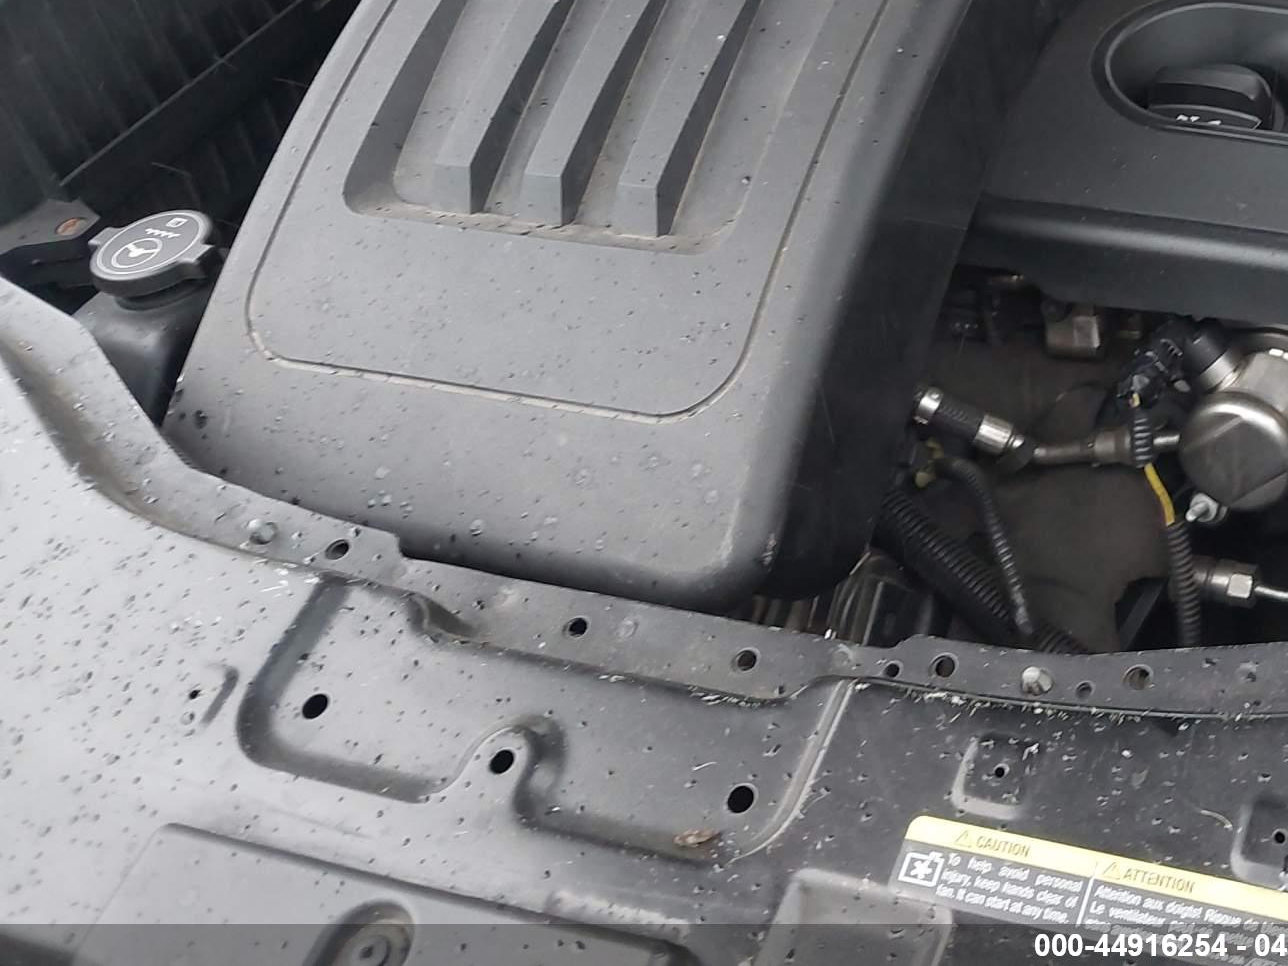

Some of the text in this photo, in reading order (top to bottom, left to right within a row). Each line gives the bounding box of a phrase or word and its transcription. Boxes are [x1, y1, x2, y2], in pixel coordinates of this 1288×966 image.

[976, 835, 1032, 858] CAUTION
[948, 853, 1083, 893] To help avoid personal
[1124, 868, 1196, 894] ATTENTION
[941, 868, 1079, 909] injury, keep hands clear of
[1094, 884, 1142, 906] Attention
[1142, 897, 1164, 911] aux
[935, 884, 955, 899] fan.
[965, 891, 985, 906] can
[985, 895, 1011, 911] start
[1010, 900, 1024, 914] at
[1021, 903, 1044, 920] any
[1042, 907, 1070, 924] time.
[1089, 900, 1106, 915] Le
[1109, 906, 1166, 928] ventilateur
